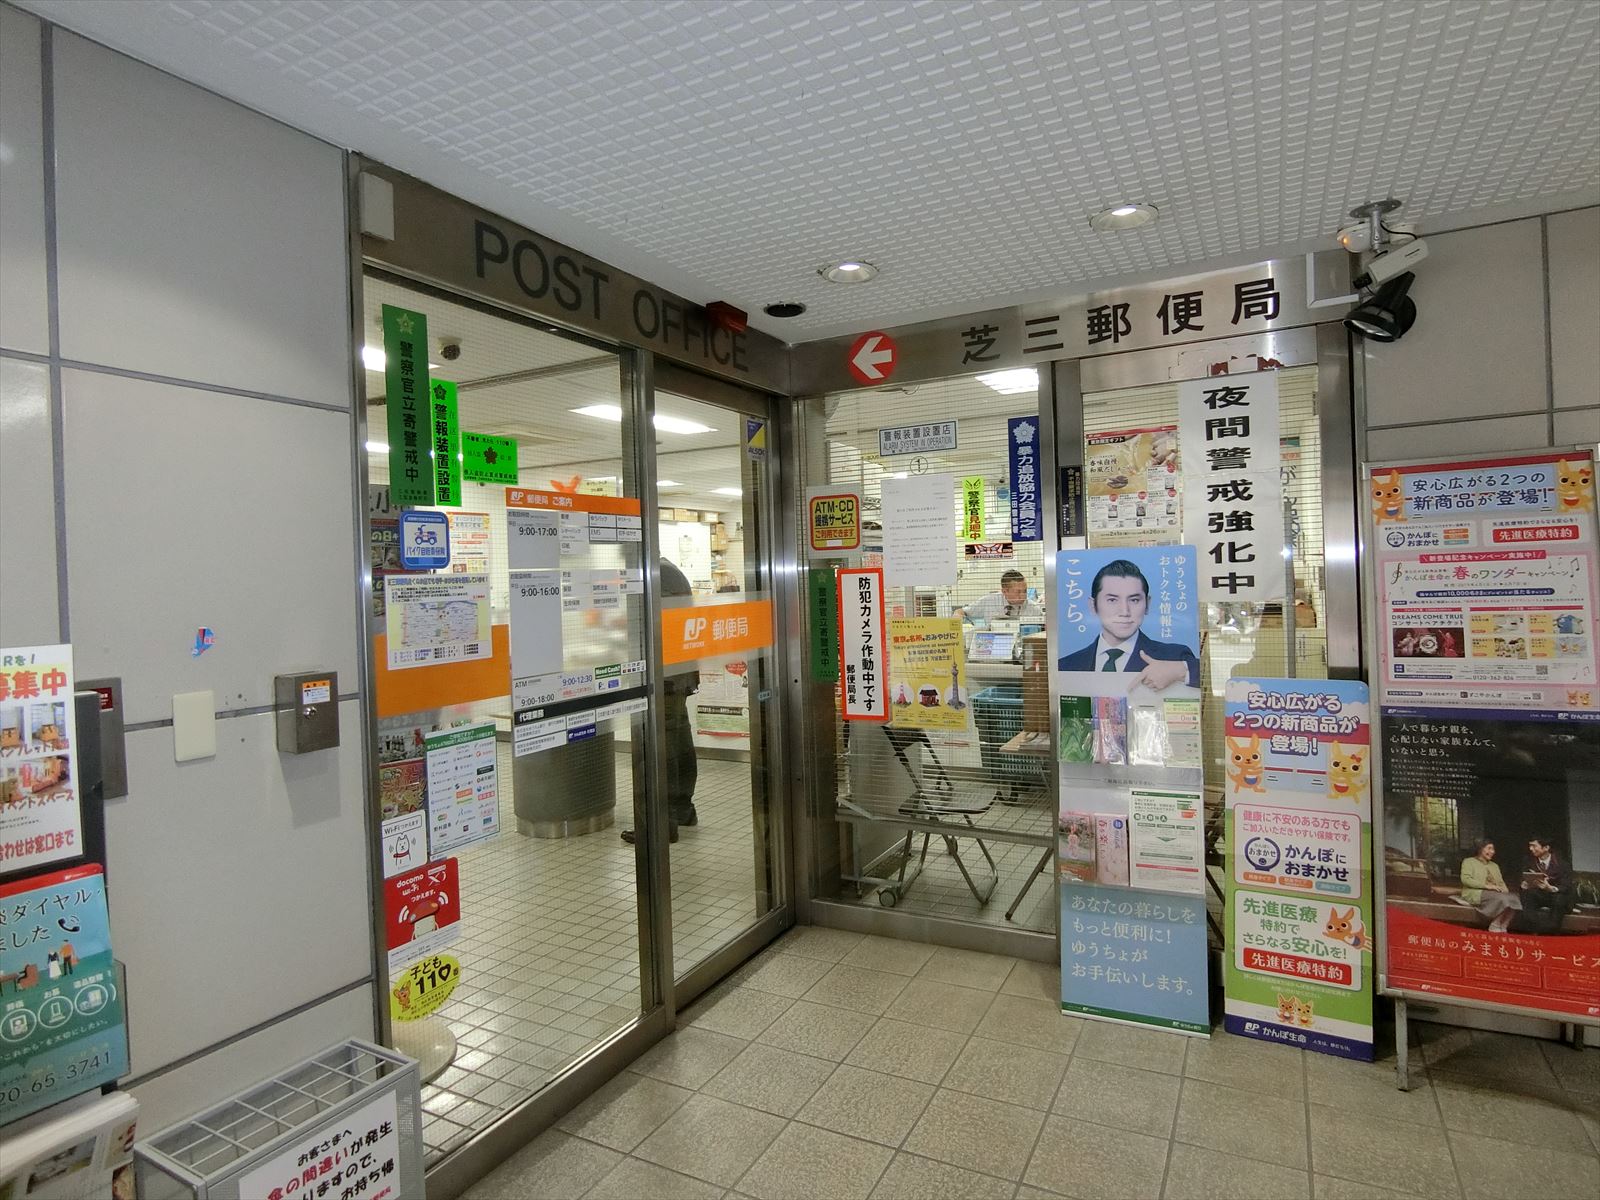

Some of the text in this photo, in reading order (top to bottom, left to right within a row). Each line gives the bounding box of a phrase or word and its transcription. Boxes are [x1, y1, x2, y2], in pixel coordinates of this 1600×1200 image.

[475, 218, 749, 373] POST OFFICE
[961, 277, 1280, 364] 芝三郵便局
[400, 341, 419, 483] 警察官立寄警戒中
[884, 424, 951, 442] 警報装置設置店
[900, 439, 919, 449] SYSTEM
[434, 403, 451, 502] 警報装置設置
[1203, 386, 1255, 594] 夜間警戒強化中
[1413, 472, 1546, 492] 安心広がる2つの
[1413, 488, 1548, 511] 新商品が登場!
[815, 513, 854, 527] 提携サービス
[519, 527, 558, 536] 9:00-17:00
[815, 527, 855, 539] ご利用できます
[1499, 527, 1574, 541] 先進医療特約
[521, 587, 560, 597] 9:00-16:00
[1175, 555, 1187, 611] ゆうちょの
[1066, 558, 1087, 633] こちら。
[1159, 556, 1173, 638] おトクな情報は
[712, 616, 749, 642] 郵便局
[858, 577, 876, 711] 防犯カメラ作動中です
[514, 680, 528, 689] ATM
[562, 674, 593, 686] 9:00-12:30
[846, 665, 857, 705] 郵便局長
[521, 693, 555, 707] 9:00-18:00
[1247, 690, 1342, 713] 安心広がる
[1233, 712, 1360, 734] 2つの新商品が
[1389, 723, 1475, 735] 一人で暮らす親を、
[1271, 734, 1318, 755] 登場!
[1389, 734, 1497, 748] 心配しない家族なんて、
[1390, 747, 1451, 758] いないと思う。
[1243, 810, 1351, 831] 健康に不安のある方でも
[1242, 823, 1351, 842] ご加入いただきやすい保険です。
[1284, 844, 1347, 865] かんぽに
[396, 873, 424, 889] docomo
[1284, 861, 1349, 882] おまかせ
[1071, 895, 1196, 924] あなたの暮らしを
[1243, 897, 1318, 924] 先進医療
[1072, 918, 1171, 944] もっと便利に!
[1260, 918, 1300, 935] 特約で
[1071, 942, 1148, 962] ゆうちょが
[1242, 931, 1347, 960] さらなる安心を!
[1407, 934, 1600, 968] 郵便局のみまもりサービス
[409, 957, 442, 980] 子ども
[1252, 952, 1344, 981] 先進医療特約
[1071, 964, 1194, 996] お手伝いします。
[1262, 1027, 1307, 1043] かんぽ生命
[298, 1129, 353, 1167] お客さまへ
[267, 1121, 393, 1200] 傘の間違いが発生
